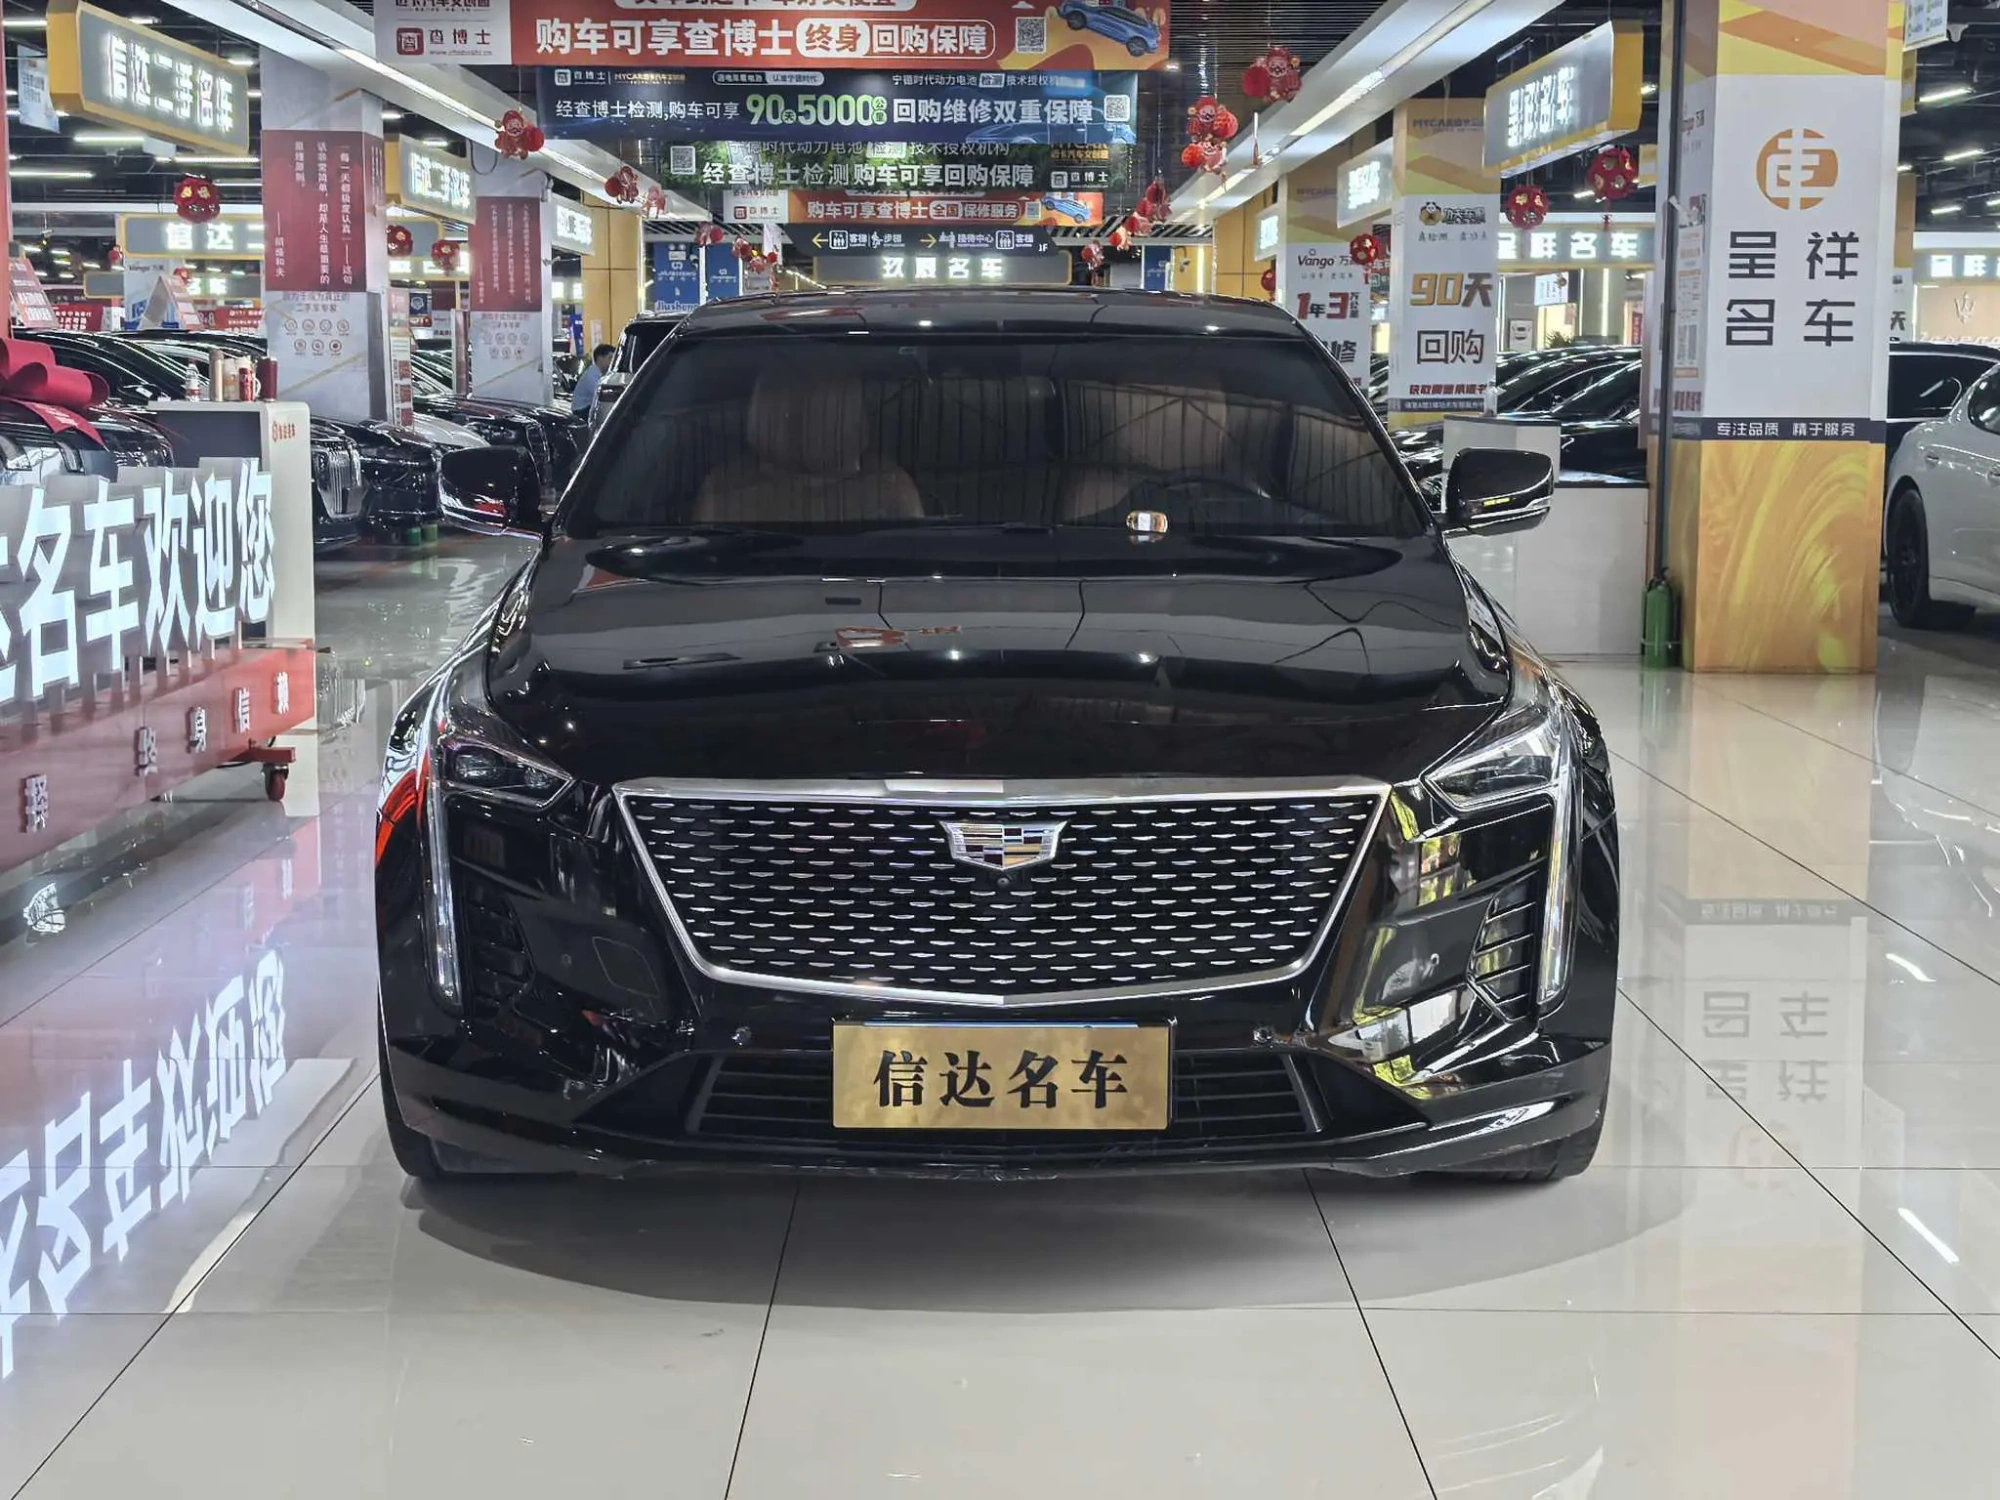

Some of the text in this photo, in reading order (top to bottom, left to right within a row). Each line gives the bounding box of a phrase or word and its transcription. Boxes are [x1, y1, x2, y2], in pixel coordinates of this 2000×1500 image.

[536, 18, 987, 57] 购车可享查博士终身回购保障
[893, 98, 1093, 124] 回购维修双重保障
[702, 162, 1034, 188] 经查博士检测购车可享回购保障
[1728, 230, 1860, 280] 呈祥
[1409, 272, 1494, 308] 90天
[1725, 298, 1856, 348] 名车
[1416, 327, 1485, 366] 回购
[1716, 421, 1857, 437] 专注品质 精于服务
[0, 457, 276, 702] 名车欢迎您
[873, 1050, 1128, 1109] 信达名车
